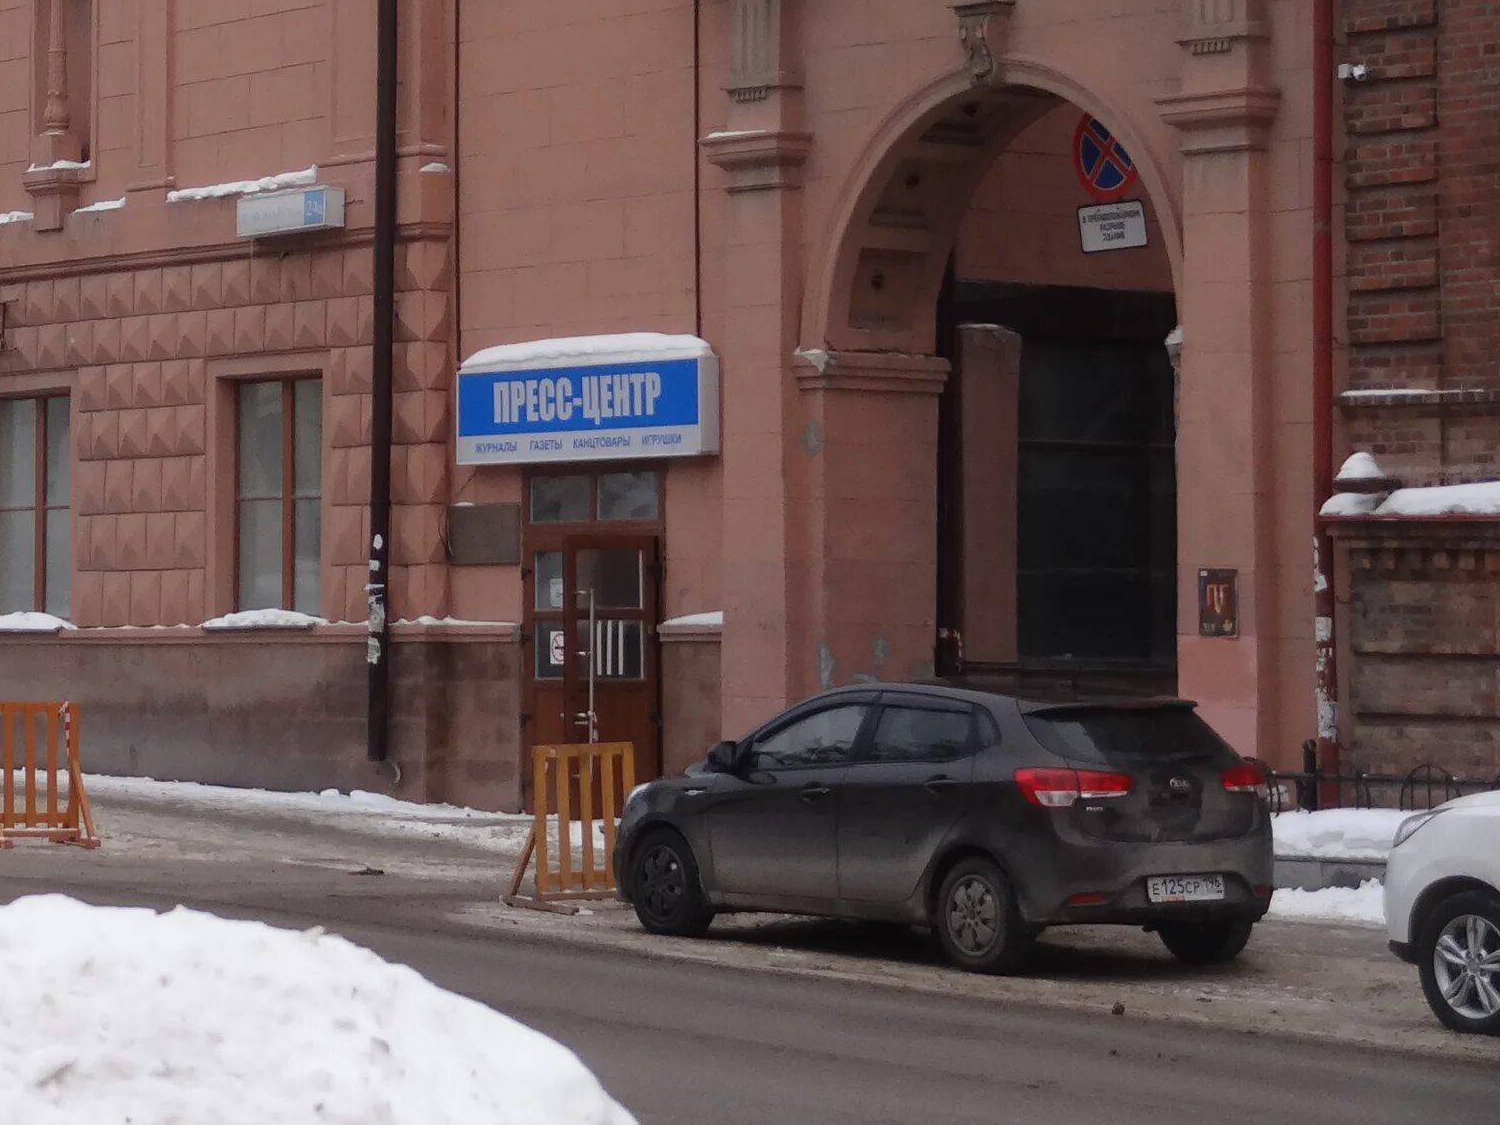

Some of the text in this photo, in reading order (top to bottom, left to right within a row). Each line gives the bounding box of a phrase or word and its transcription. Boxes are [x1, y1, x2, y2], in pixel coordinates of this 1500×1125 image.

[493, 371, 661, 426] ПРЕСС-ЦЕНТР
[475, 433, 682, 454] ЖУРНАЛЫ ГАЗЕТЫ КАНЦТОВАРЫ ИГРУШКИ
